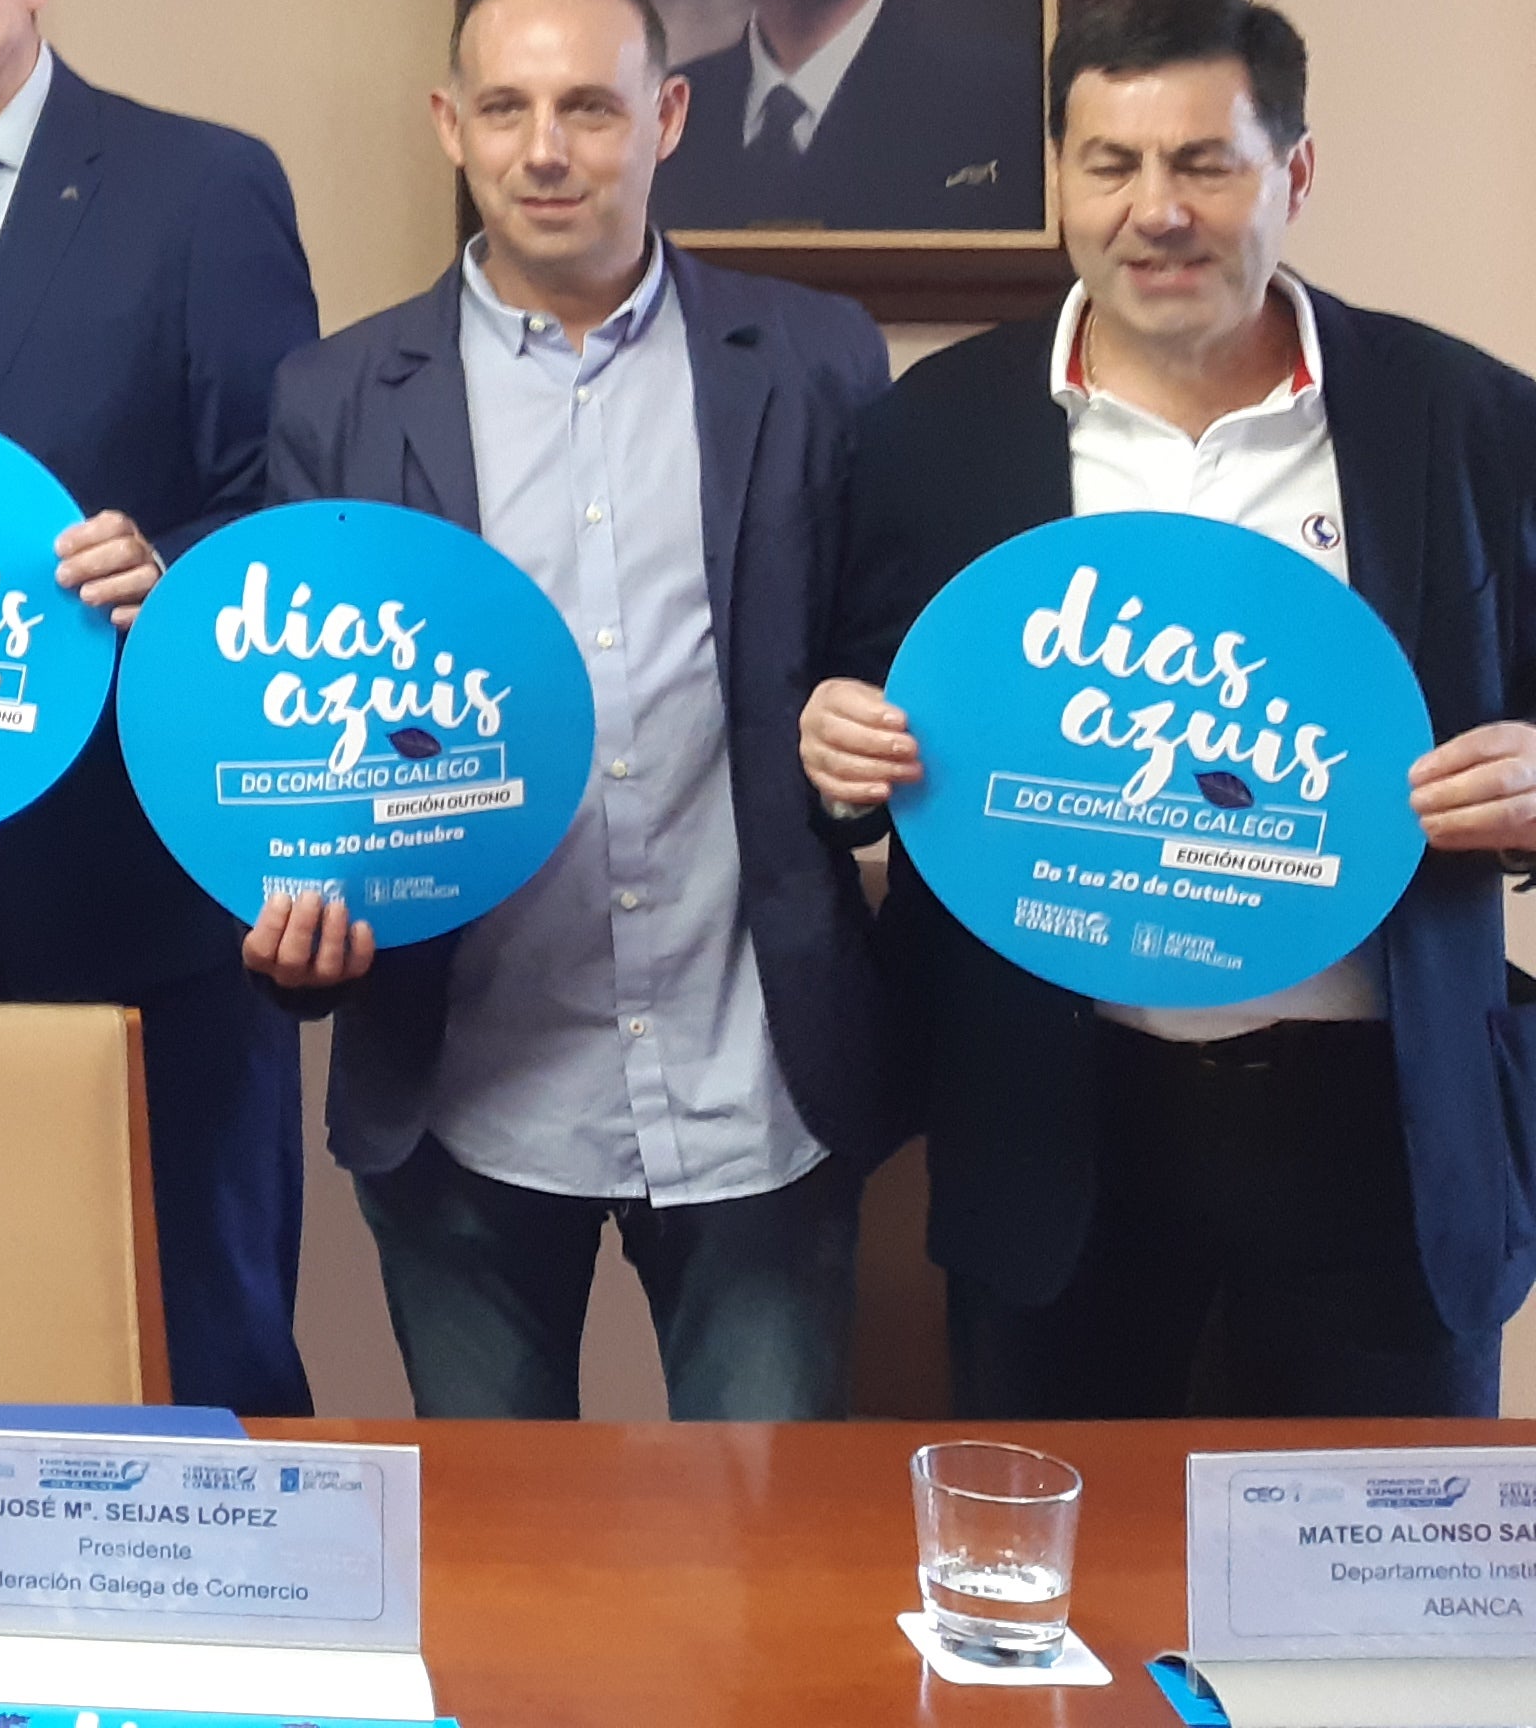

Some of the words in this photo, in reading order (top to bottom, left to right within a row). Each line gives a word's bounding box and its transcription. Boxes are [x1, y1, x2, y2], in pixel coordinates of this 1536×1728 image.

[215, 561, 426, 670] días
[1023, 565, 1266, 708] días
[263, 652, 511, 772] azuis
[1061, 687, 1348, 805] azuis
[242, 774, 272, 793] DO
[395, 757, 480, 785] GALEGO
[387, 795, 445, 817] EDICIÓN
[448, 790, 510, 809] OUTONO
[1015, 788, 1053, 811] DO
[1058, 794, 1188, 828] COMERCIO
[1194, 810, 1294, 840] GALEGO
[270, 839, 294, 857] Do
[298, 839, 305, 856] 1
[310, 843, 332, 856] ao
[336, 836, 361, 854] 20
[364, 834, 385, 851] de
[390, 826, 464, 848] Outubro
[1177, 849, 1245, 870] EDICIÓN
[1247, 857, 1322, 879] OUTONO
[1033, 861, 1062, 881] Do
[1068, 865, 1077, 882] 1
[1079, 873, 1105, 887] ao
[1109, 871, 1139, 891] 20
[1143, 875, 1168, 896] de
[1173, 878, 1261, 907] Outubro
[106, 1504, 190, 1524] SEIJAS
[199, 1503, 278, 1527] LÓPEZ
[79, 1538, 192, 1560] Presidente
[1300, 1525, 1382, 1544] MATEO
[1391, 1524, 1491, 1542] ALONSO
[90, 1573, 164, 1598] Galega
[173, 1576, 198, 1596] de
[207, 1579, 308, 1600] Comercio
[1331, 1562, 1480, 1584] Departamento
[1424, 1598, 1523, 1617] ABANCA
